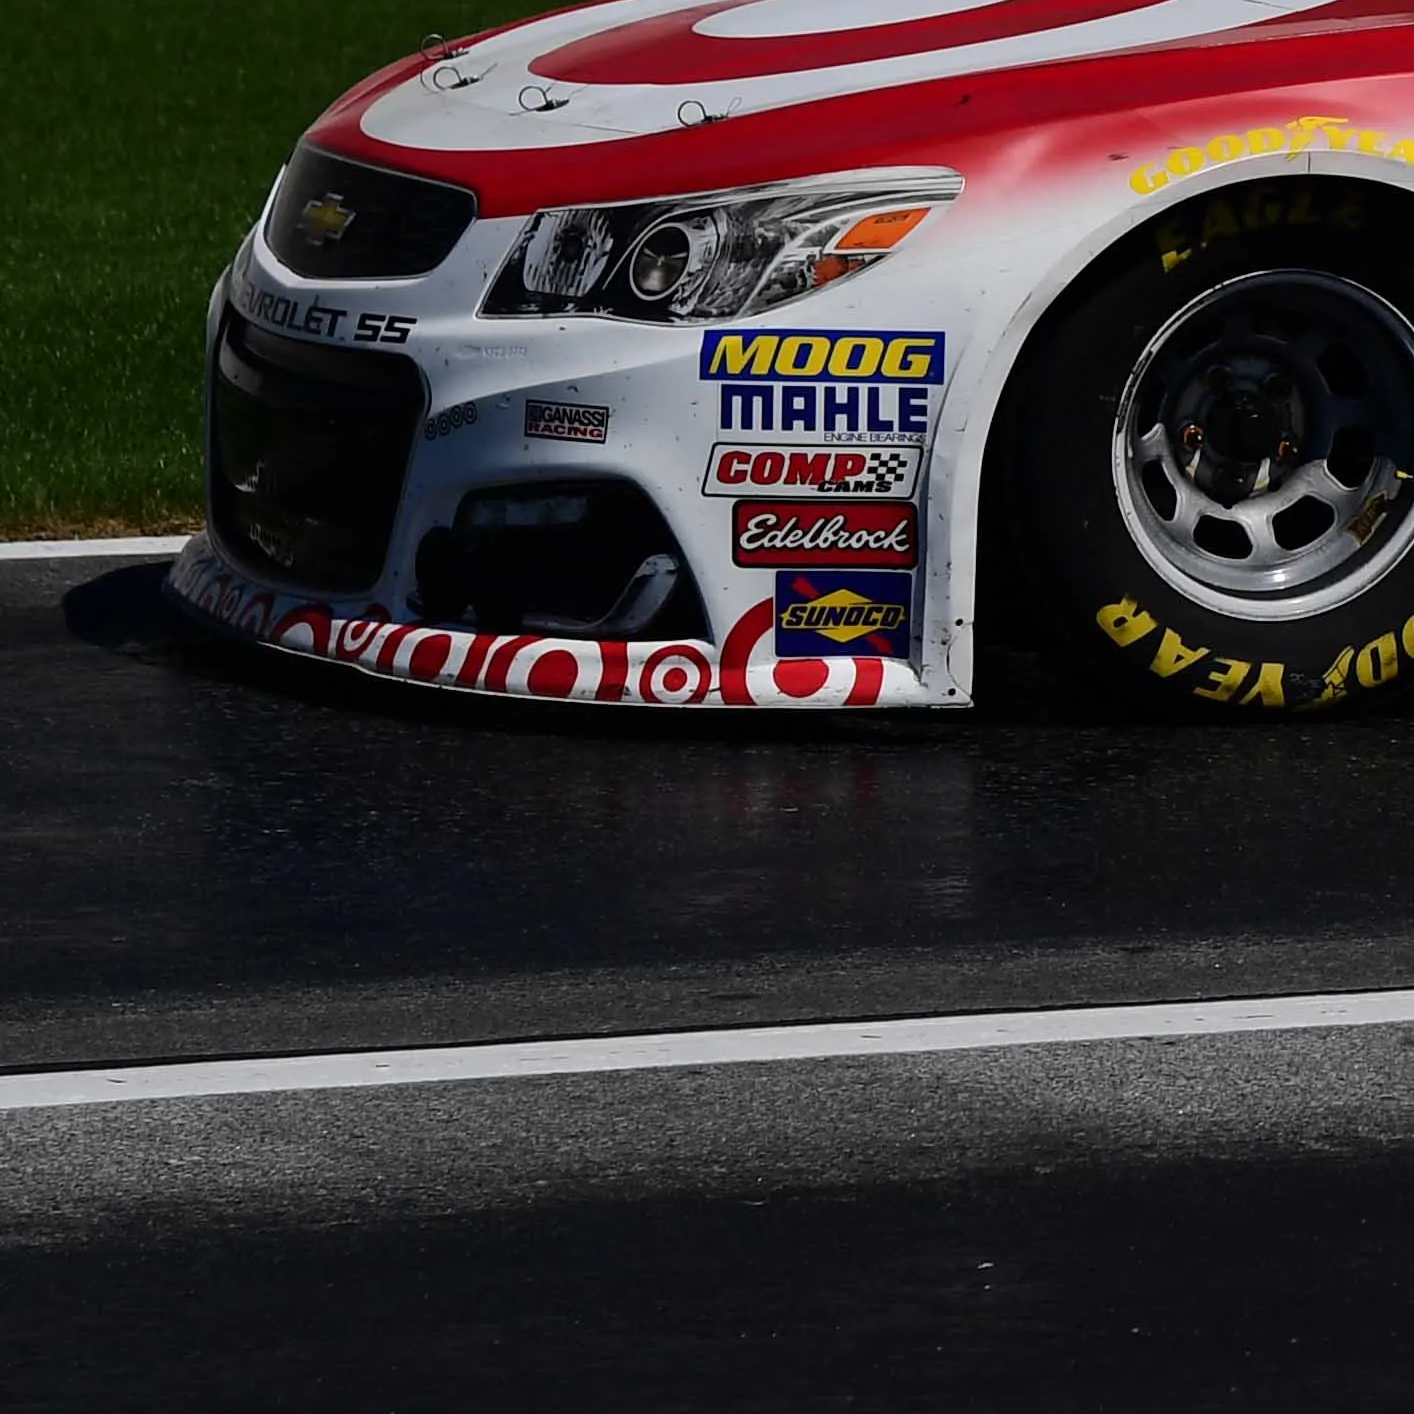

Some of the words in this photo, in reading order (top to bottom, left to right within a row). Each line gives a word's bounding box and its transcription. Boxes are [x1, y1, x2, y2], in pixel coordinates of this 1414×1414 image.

[353, 312, 418, 345] SS
[708, 334, 936, 379] MOOG
[542, 404, 606, 429] GANASSI
[720, 383, 929, 433] MAHLE
[526, 420, 604, 440] RACING
[823, 432, 869, 444] ENGINE
[869, 432, 928, 445] BEARINGS
[715, 449, 867, 486] COMP
[815, 480, 894, 494] CAMS
[738, 513, 911, 553] Edelbrock
[784, 604, 902, 628] SUNOCO
